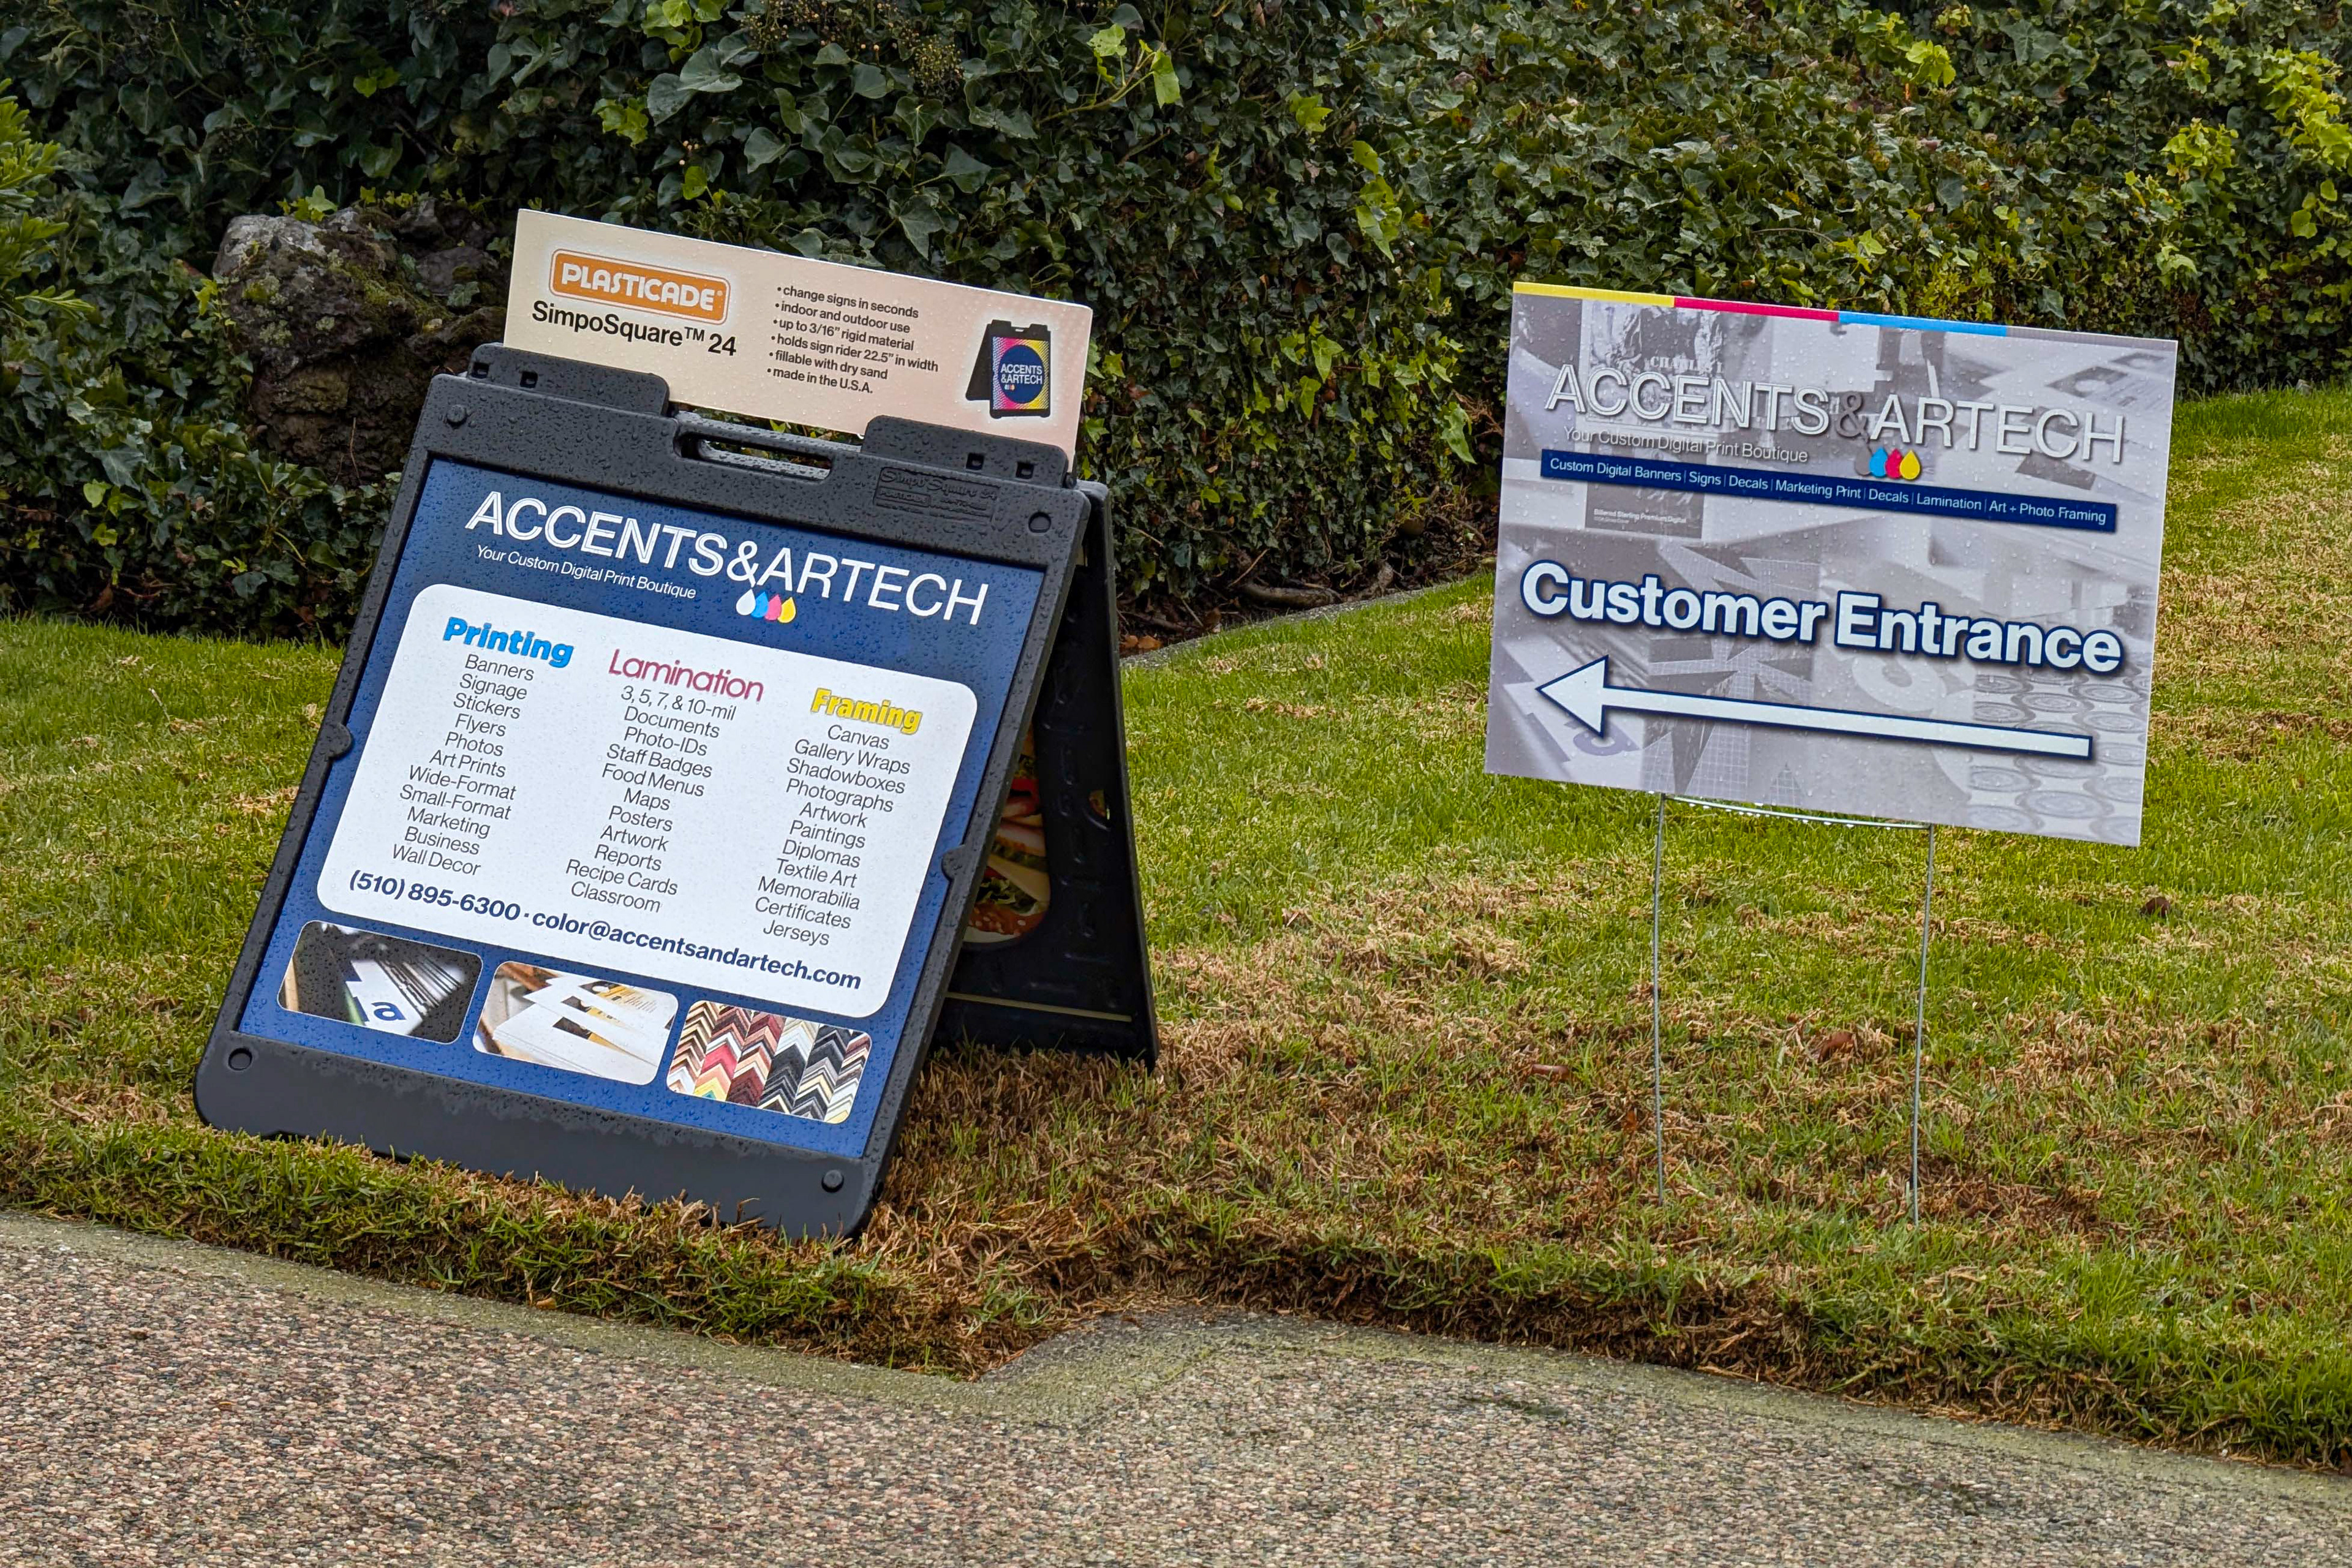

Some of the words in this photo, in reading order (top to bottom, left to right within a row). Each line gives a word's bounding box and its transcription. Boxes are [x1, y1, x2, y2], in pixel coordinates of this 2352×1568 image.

[820, 308, 841, 321] and
[843, 314, 888, 328] outdoor
[889, 322, 911, 333] use
[826, 293, 857, 307] signs
[859, 298, 869, 309] in
[870, 302, 919, 318] seconds
[707, 333, 737, 356] 24
[796, 320, 807, 331] to
[842, 330, 867, 343] rigid
[868, 336, 914, 351] material
[810, 341, 833, 354] sign
[835, 345, 862, 358] rider
[895, 354, 905, 366] in
[908, 358, 938, 372] width
[814, 358, 838, 370] with
[840, 362, 858, 375] dry
[860, 368, 888, 379] sand
[1000, 363, 1043, 374] ACCENTS
[807, 372, 817, 383] in
[819, 375, 837, 386] the
[839, 377, 873, 393] U.S.A.
[1000, 374, 1043, 385] &ARTECH
[1563, 425, 1594, 443] Your
[1597, 430, 1656, 448] Custom
[1657, 436, 1703, 453] Digital
[1705, 440, 1740, 456] Print
[1741, 443, 1809, 463] Boutique
[1550, 458, 1594, 473] Custom
[1597, 462, 1632, 478] Digital
[1634, 466, 1682, 482] Banners
[1688, 471, 1722, 487] Signs
[1728, 475, 1769, 490] Decals
[1776, 480, 1833, 497] Marketing
[1836, 485, 1861, 499] Print
[1868, 489, 1909, 503] Decals
[1916, 493, 1982, 511] Lamination
[1988, 500, 2007, 513] Art
[2019, 503, 2055, 518] Photo
[2057, 507, 2107, 526] Framing
[477, 544, 507, 561] Your
[507, 550, 560, 574] Custom
[560, 560, 603, 584] Digital
[603, 568, 637, 589] Print
[637, 576, 698, 600] Boutique
[1521, 560, 1829, 645] Customer
[1836, 590, 2124, 674] Entrance
[442, 616, 575, 669] Printing
[464, 653, 535, 682] Banners
[608, 648, 764, 703] Lamination
[459, 673, 528, 702] Signage
[620, 684, 635, 704] 3,
[638, 688, 653, 708] 5,
[657, 691, 670, 710] 7,
[671, 694, 684, 712] &
[687, 698, 737, 722] 10-mil
[453, 692, 521, 720] Stickers
[810, 687, 923, 734] Framing
[454, 712, 507, 737] Flyers
[624, 705, 720, 739] Documents
[827, 723, 890, 750] Canvas
[444, 731, 504, 757] Photos
[623, 725, 708, 757] Photo-IDs
[794, 738, 856, 766] Gallery
[857, 749, 911, 775] Wraps
[428, 748, 458, 769] Art
[457, 753, 507, 778] Prints
[606, 742, 649, 765] Staff
[647, 750, 713, 778] Badges
[786, 757, 906, 794] Shadowboxes
[409, 764, 518, 801] Wide-Format
[601, 762, 647, 786] Food
[647, 771, 705, 797] Menus
[785, 777, 894, 813] Photographs
[399, 783, 512, 821] Small-Format
[622, 786, 671, 812] Maps
[406, 805, 491, 840] Marketing
[608, 804, 674, 832] Posters
[798, 801, 869, 829] Artwork
[404, 825, 480, 856] Business
[599, 824, 669, 853] Artwork
[788, 819, 866, 850] Paintings
[392, 843, 429, 865] Wall
[427, 850, 482, 876] Decor
[594, 843, 663, 872] Reports
[782, 839, 861, 869] Diplomas
[565, 858, 625, 885] Recipe
[627, 871, 679, 896] Cards
[776, 857, 829, 883] Textile
[829, 869, 858, 889] Art
[570, 880, 662, 913] Classroom
[757, 875, 861, 911] Memorabilia
[755, 895, 852, 930] Certificates
[349, 869, 406, 900] (510)
[407, 882, 521, 921] 895-6300
[532, 912, 862, 990] color@accentsandartech.com
[762, 919, 830, 947] Jerseys
